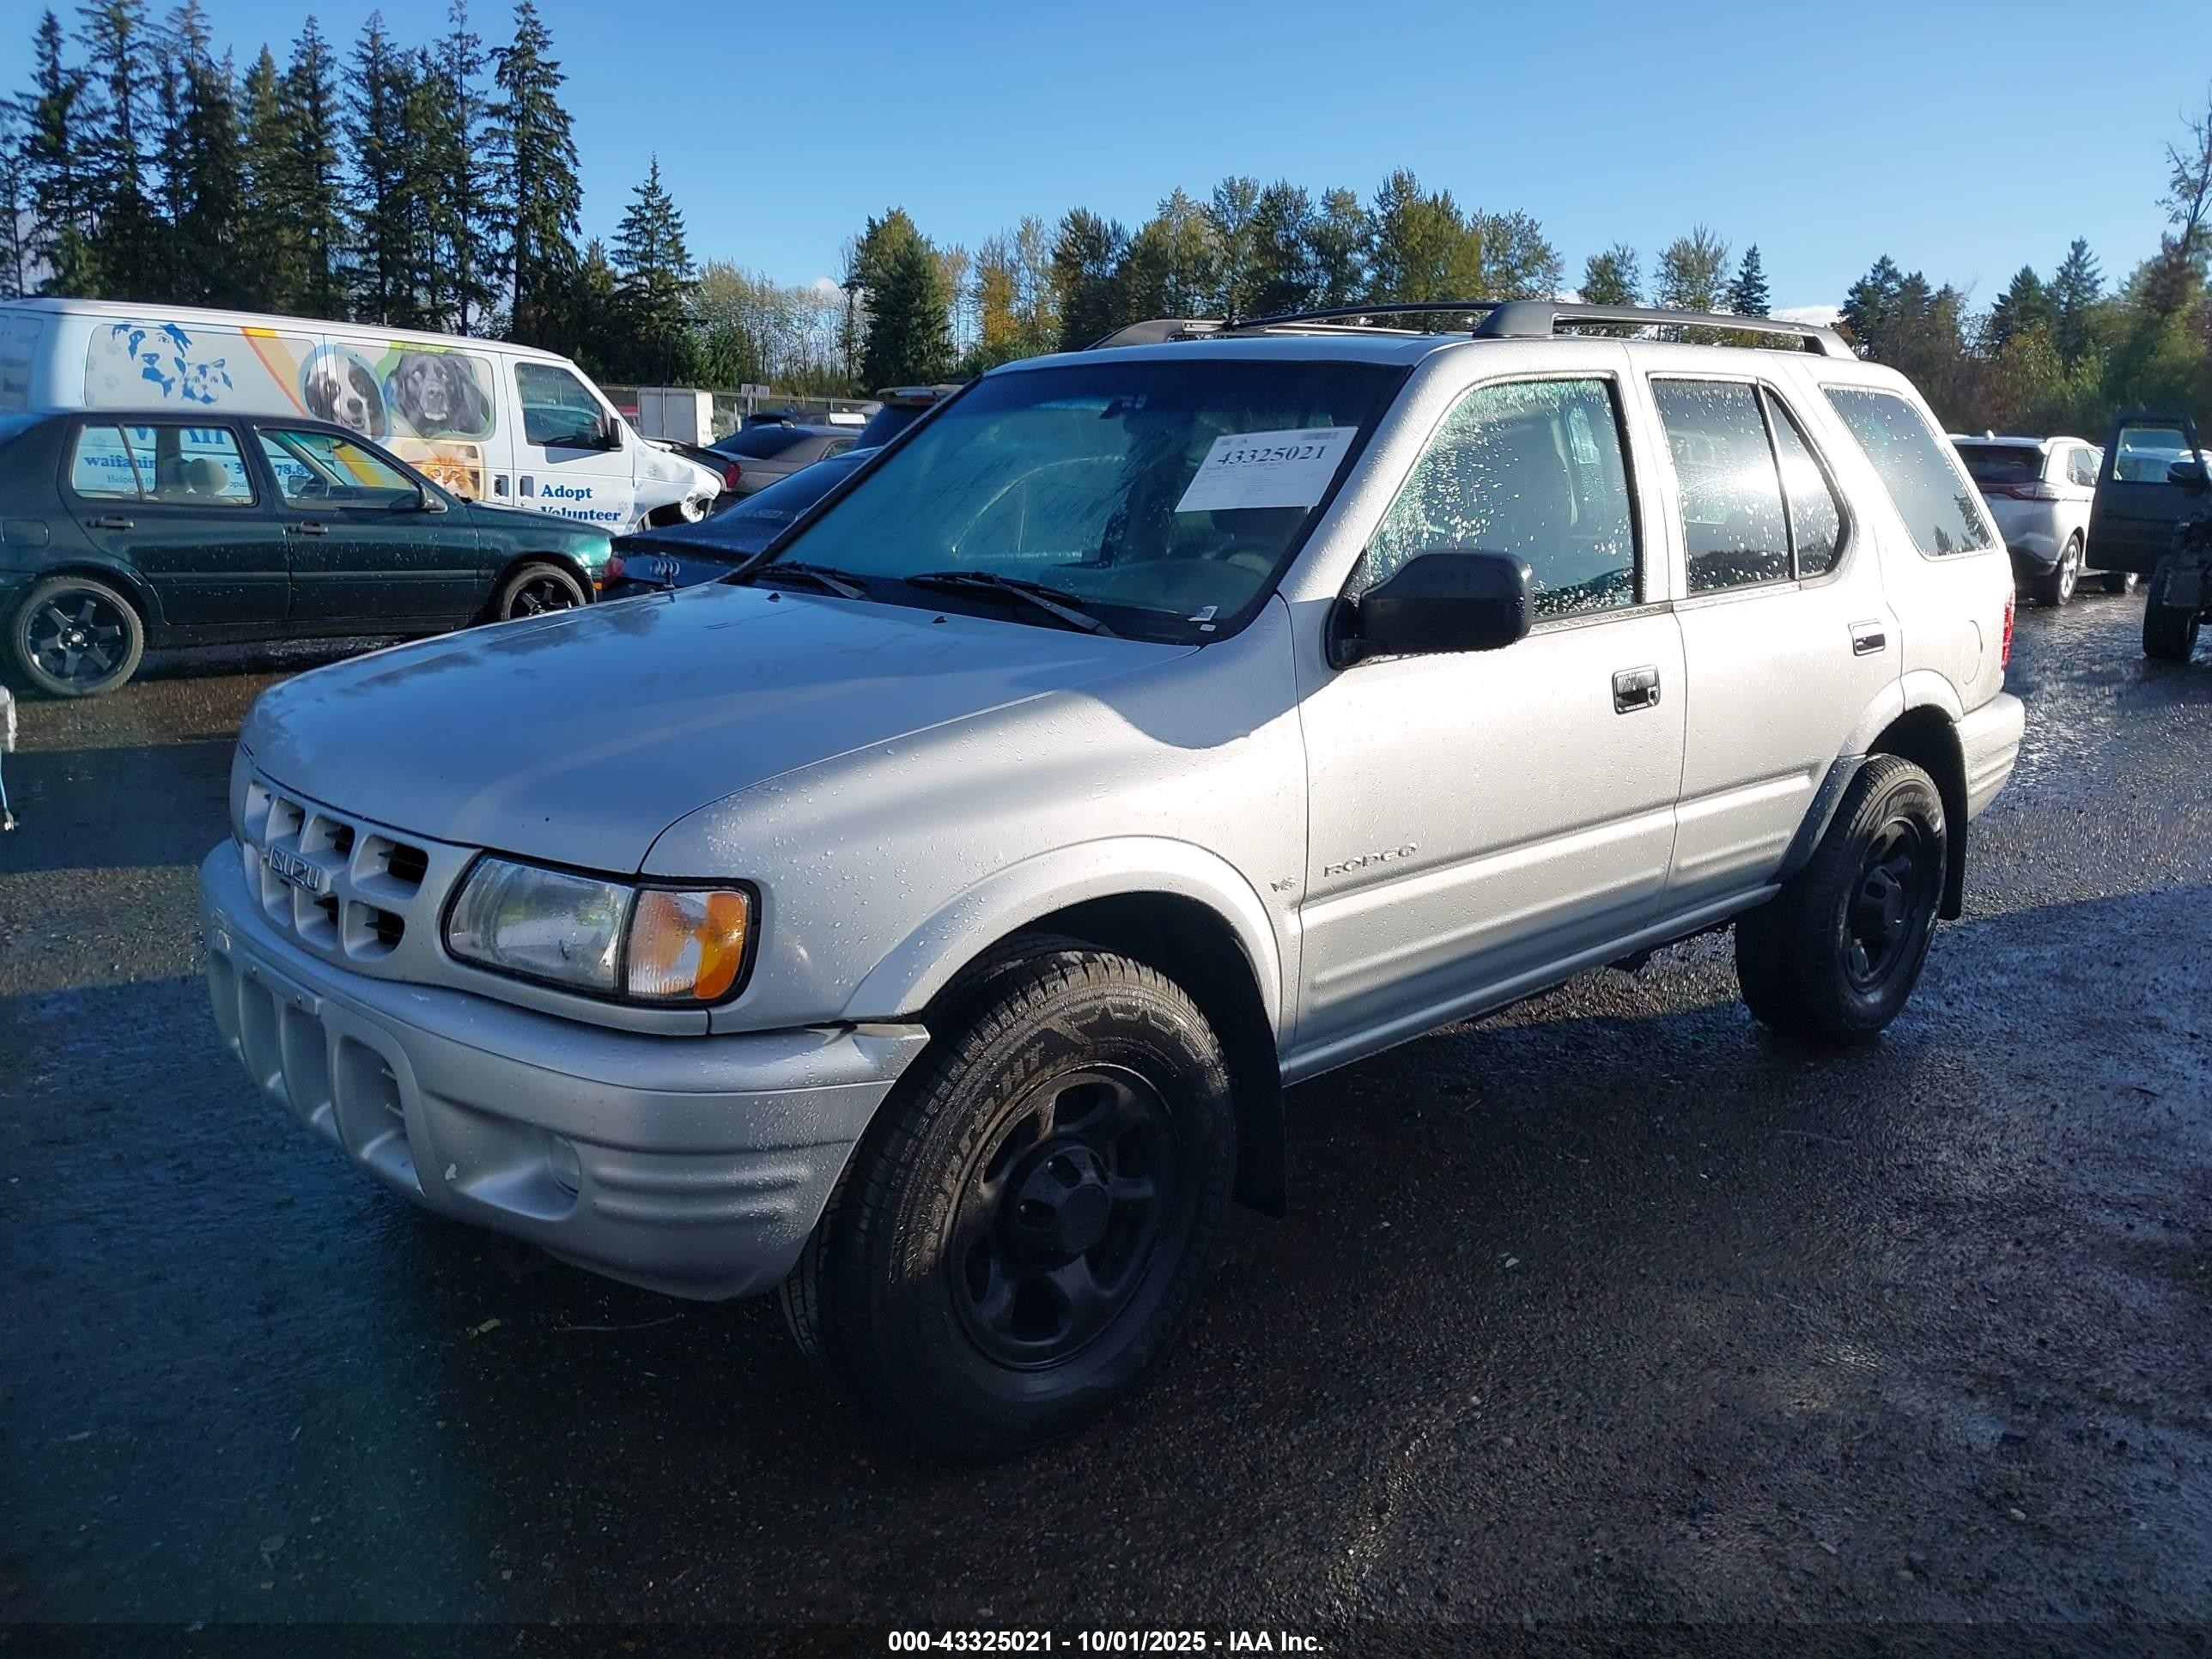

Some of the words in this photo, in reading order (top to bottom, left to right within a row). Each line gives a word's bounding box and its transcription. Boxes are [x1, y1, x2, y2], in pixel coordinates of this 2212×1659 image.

[1217, 445, 1327, 465] 43325021
[541, 483, 592, 501] Adopt
[269, 845, 321, 889] ISUZU
